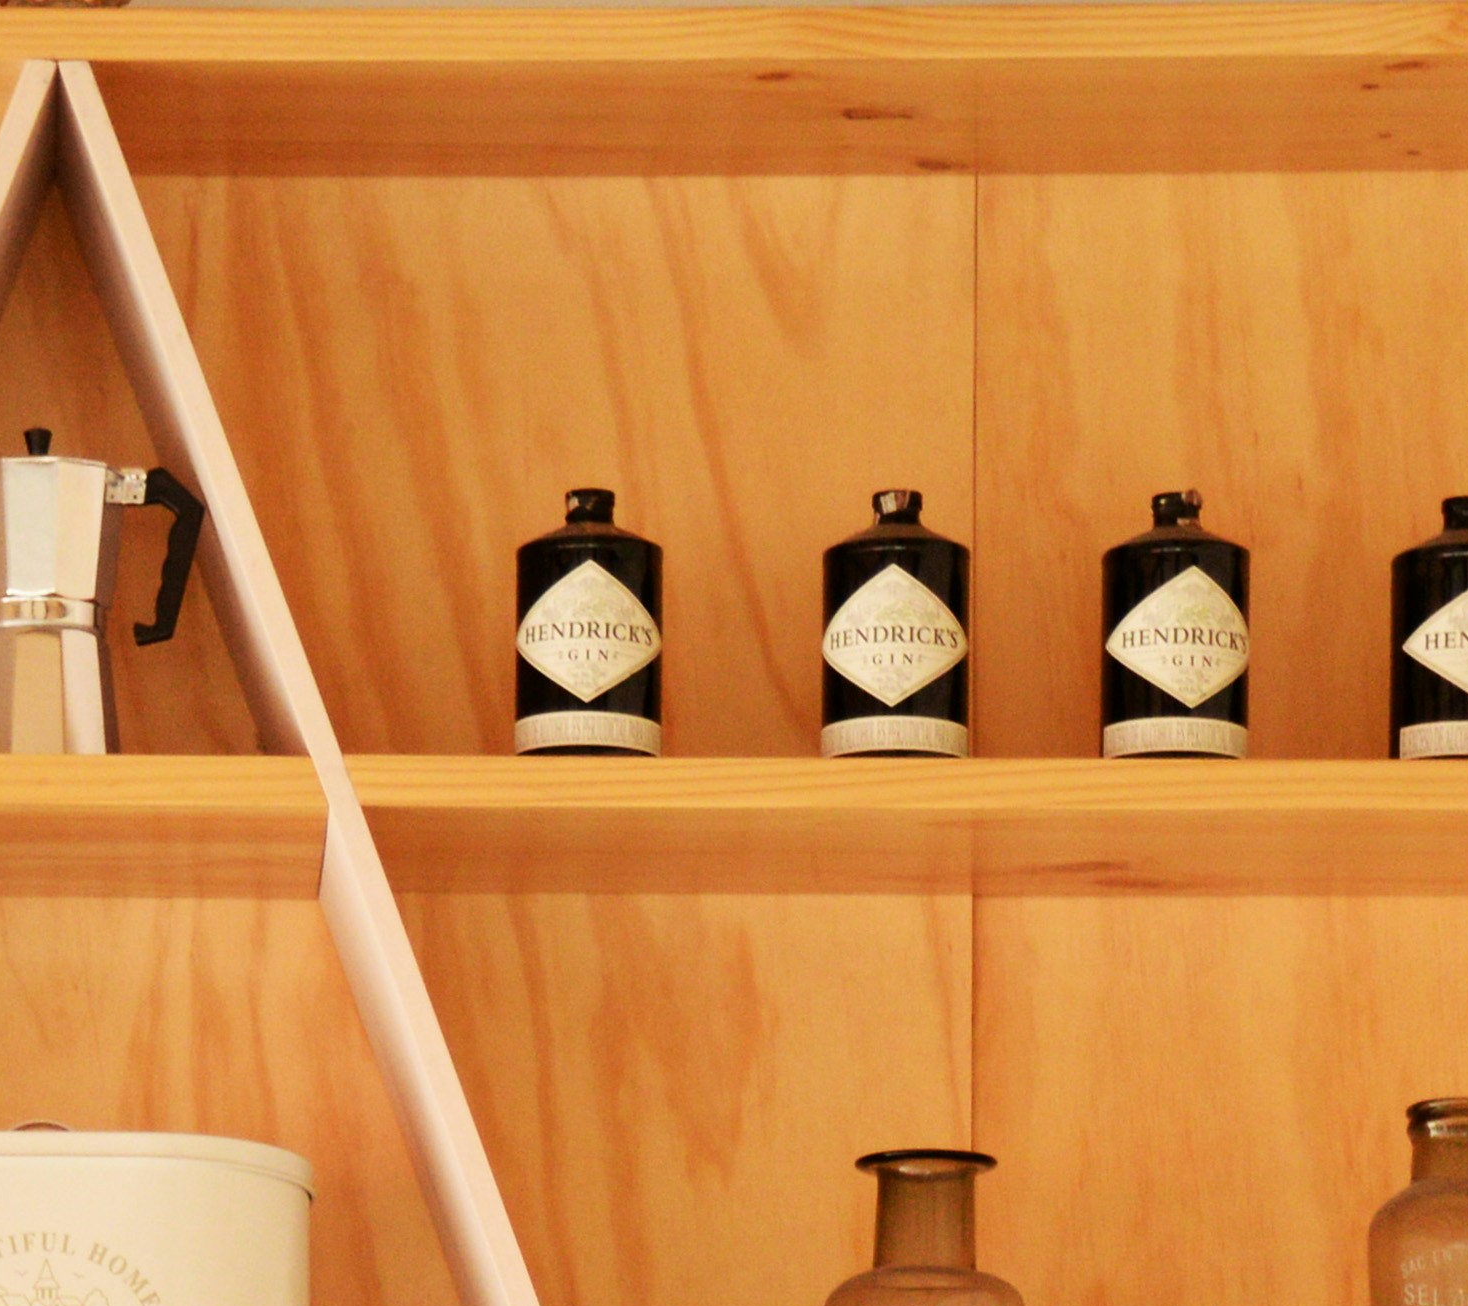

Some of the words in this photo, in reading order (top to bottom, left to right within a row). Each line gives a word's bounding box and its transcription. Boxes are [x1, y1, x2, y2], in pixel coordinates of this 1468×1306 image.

[524, 619, 654, 647] HENDRICK'S
[829, 624, 960, 651] HENDRICK'S
[1121, 625, 1249, 653] HENDRICK'S
[567, 648, 612, 662] GIN
[872, 652, 915, 666] GIN
[1172, 654, 1215, 668] GIN
